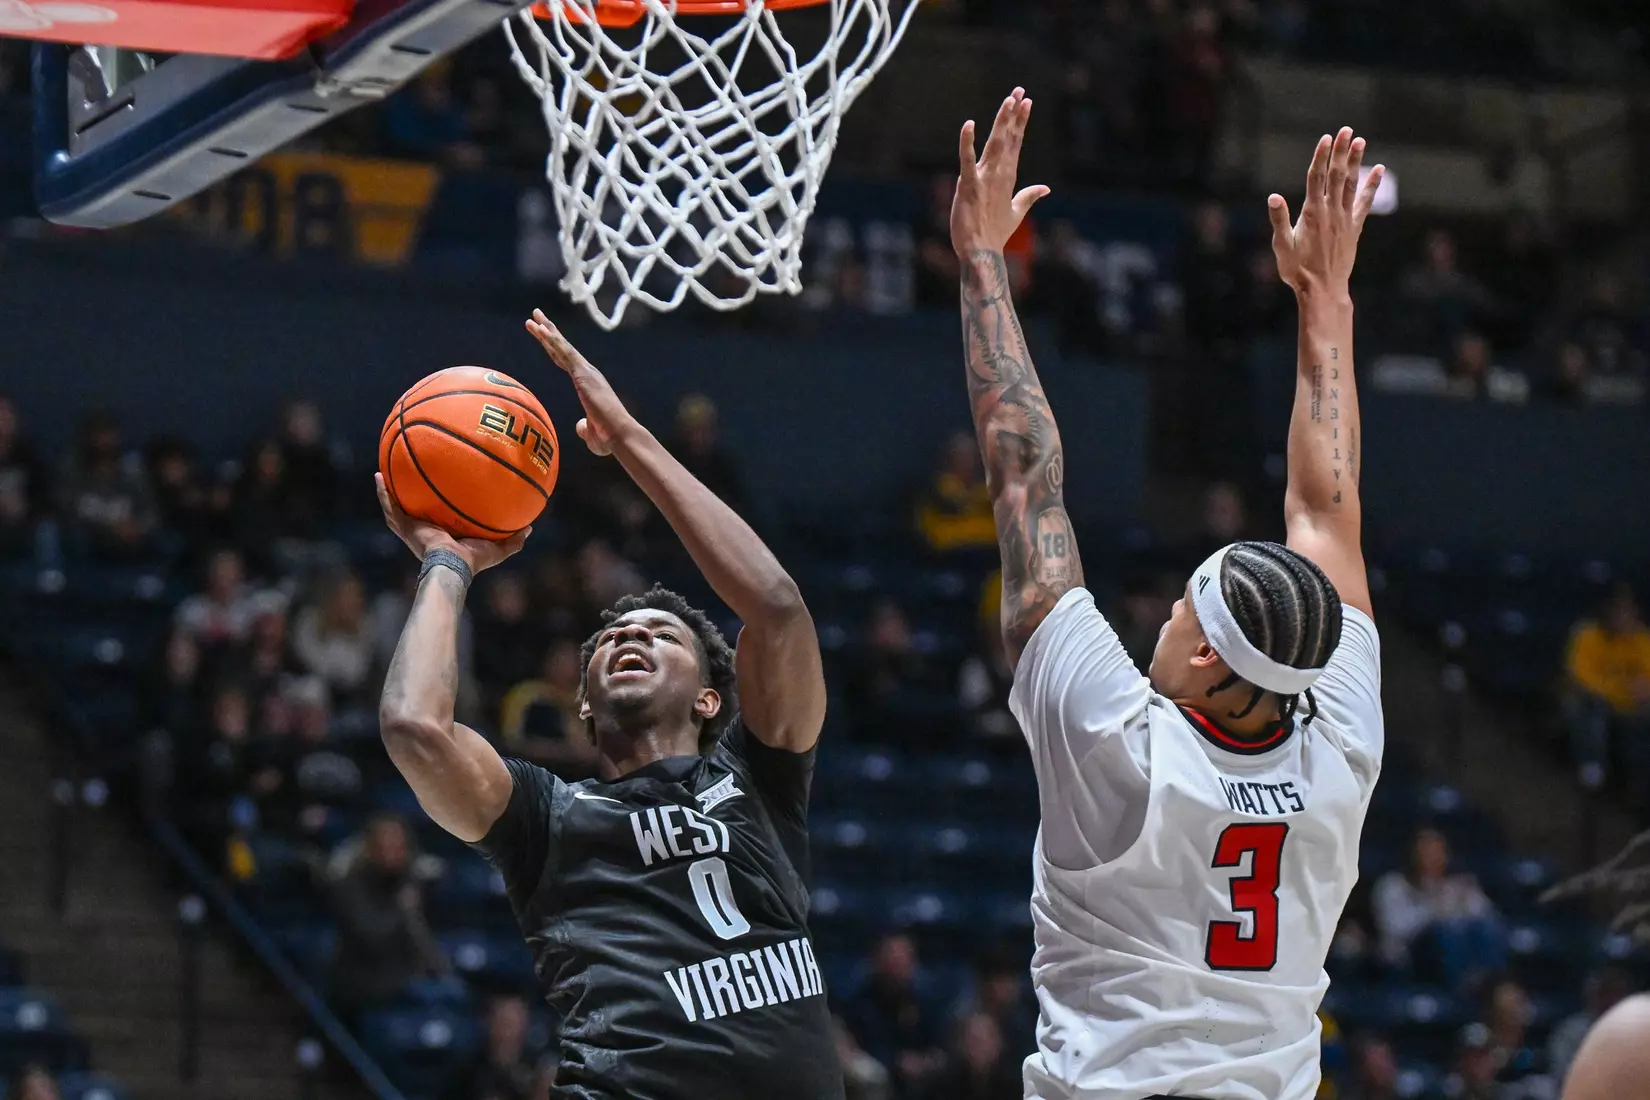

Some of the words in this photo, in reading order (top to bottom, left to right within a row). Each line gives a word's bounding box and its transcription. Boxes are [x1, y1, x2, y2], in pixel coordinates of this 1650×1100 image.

[480, 403, 554, 468] ELITE
[1218, 777, 1305, 815] WATTS
[687, 857, 751, 941] 0
[1204, 822, 1290, 972] 3
[663, 937, 823, 1022] VIRGINIA
